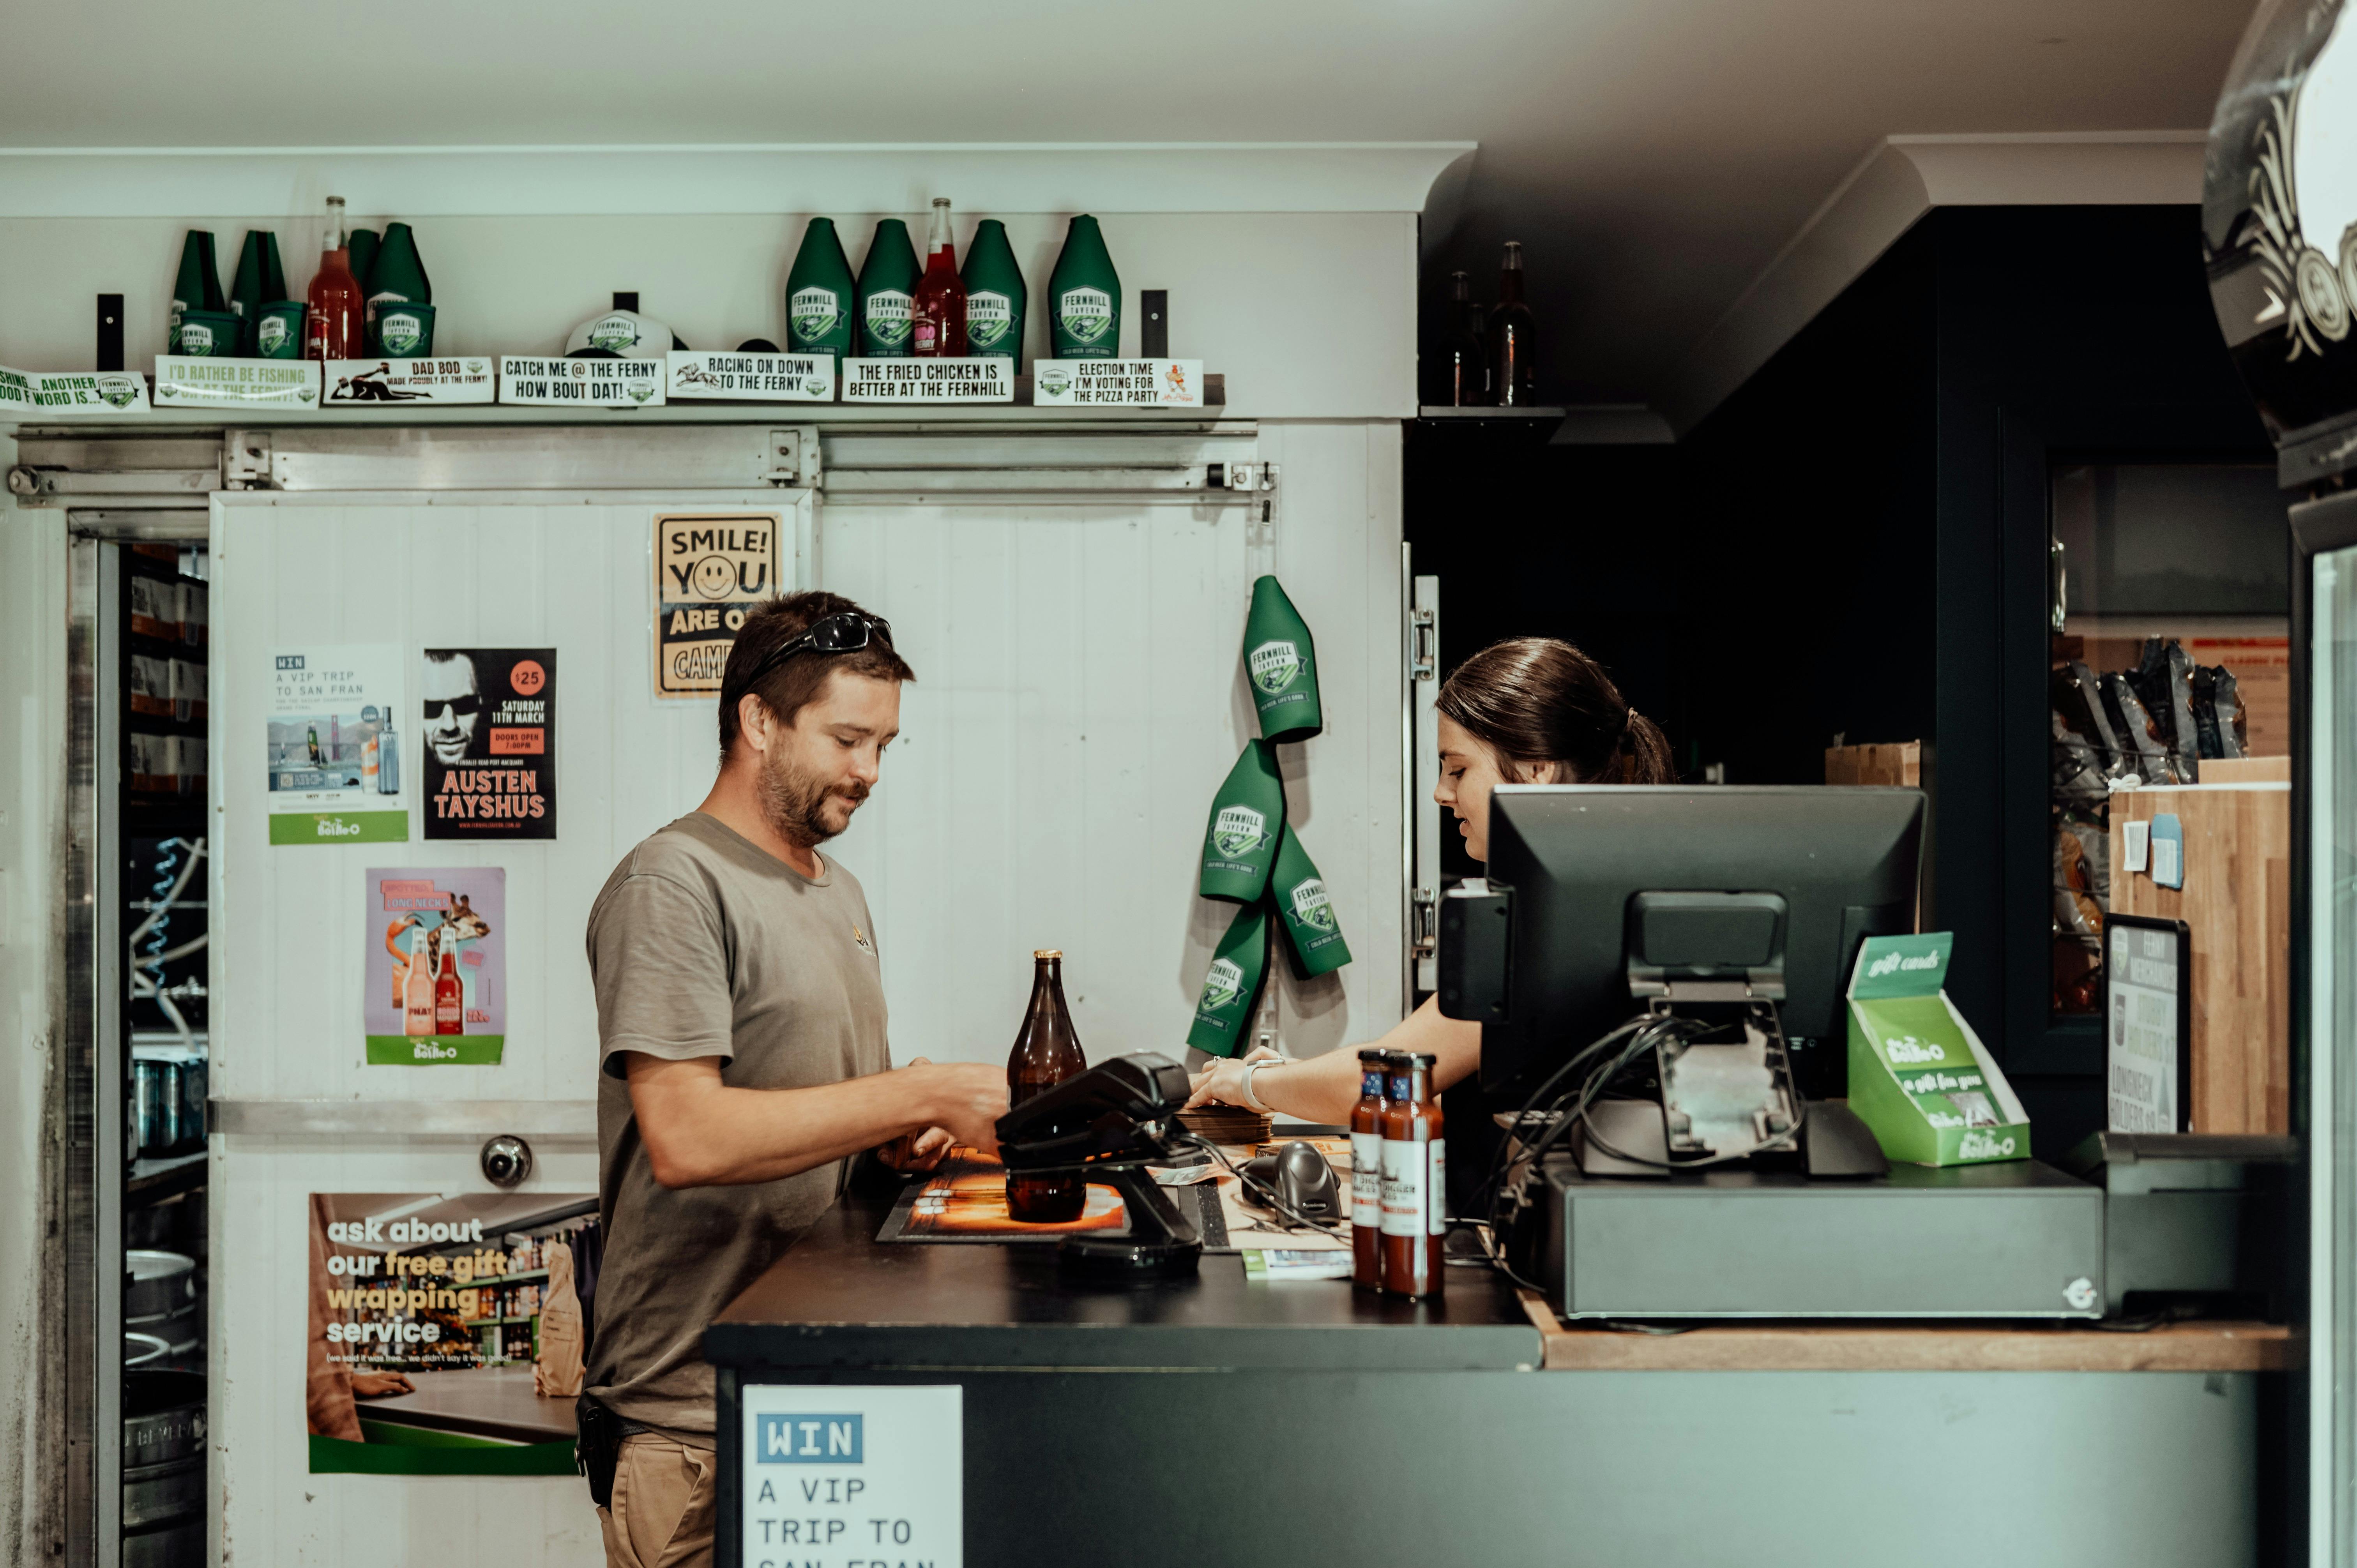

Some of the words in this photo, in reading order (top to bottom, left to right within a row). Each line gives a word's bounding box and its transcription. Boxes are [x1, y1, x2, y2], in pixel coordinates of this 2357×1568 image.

[794, 295, 832, 306] FERNHILL
[871, 298, 912, 309] FERNHILL
[1065, 295, 1107, 306] FERNHILL
[797, 306, 824, 314] TAVERN
[875, 309, 905, 317] TAVERN
[385, 319, 416, 328] FERNHILL
[598, 322, 631, 331] FERNHILL
[412, 362, 434, 375] DAD
[438, 361, 460, 374] BOD
[506, 361, 544, 376] CATCH
[549, 362, 567, 376] ME
[572, 362, 585, 378] @
[590, 363, 613, 377] THE
[618, 363, 656, 377] FERNY
[709, 358, 752, 373] RACING
[758, 359, 773, 373] ON
[778, 360, 813, 374] DOWN
[859, 365, 881, 380] THE
[887, 365, 921, 380] FRIED
[927, 364, 980, 380] CHICKEN
[986, 364, 997, 379] IS
[1080, 364, 1125, 375] ELECTION
[1129, 363, 1153, 375] TIME
[170, 365, 185, 379] I'D
[190, 365, 237, 381] RATHER
[240, 367, 254, 382] BE
[259, 368, 305, 383] FISHING
[387, 377, 406, 386] MADE
[408, 376, 438, 385] PROUDLY
[441, 376, 448, 384] AT
[451, 376, 463, 384] THE
[42, 377, 96, 391] ANOTHER
[720, 374, 733, 388] TO
[739, 375, 760, 389] THE
[765, 376, 802, 390] FERNY
[850, 383, 894, 396] BETTER
[900, 383, 915, 396] AT
[920, 383, 942, 396] THE
[948, 382, 1006, 396] FERNHILL
[1076, 377, 1091, 389] I'M
[1096, 377, 1131, 388] VOTING
[1135, 377, 1153, 388] FOR
[516, 381, 547, 397] HOW
[553, 382, 586, 399] BOUT
[592, 383, 622, 399] DAT!
[1074, 391, 1091, 402] THE
[1096, 391, 1123, 402] PIZZA
[1127, 390, 1158, 402] PARTY
[24, 390, 30, 403] F
[33, 390, 71, 405] WORD
[78, 390, 101, 404] IS...
[671, 529, 767, 555] SMILE!
[670, 609, 719, 636] ARE
[724, 609, 745, 631] O
[1253, 646, 1291, 664] FERNHILL
[278, 657, 302, 669] WIN
[1258, 658, 1286, 670] TAVERN
[276, 674, 283, 683] A
[292, 673, 315, 682] VIP
[322, 672, 354, 682] TRIP
[515, 672, 539, 685] $25
[276, 686, 291, 696] TO
[300, 685, 323, 695] SAN
[331, 684, 363, 694] FRAN
[502, 701, 545, 712] SATURDAY
[493, 713, 512, 724] 11TH
[515, 712, 544, 724] MARCH
[442, 770, 537, 793] AUSTEN
[434, 795, 545, 818] TAYSHUS
[1221, 812, 1259, 826] FERNHILL
[1223, 823, 1250, 833] TAVERN
[387, 898, 413, 908] LONG
[415, 897, 449, 908] NECKS
[1868, 952, 1902, 977] gift
[1900, 949, 1940, 971] cards
[409, 1007, 431, 1016] PHAT
[327, 1217, 383, 1242] ask
[390, 1217, 483, 1242] about
[327, 1255, 380, 1276] our
[385, 1249, 447, 1276] free
[453, 1248, 508, 1284] gift
[327, 1282, 479, 1318] wrapping
[327, 1315, 440, 1342] service
[327, 1353, 341, 1362] (we
[343, 1354, 359, 1362] said
[422, 1354, 445, 1362] didn't
[447, 1355, 461, 1364] say
[768, 1421, 852, 1456] WIN
[758, 1480, 776, 1503] A
[802, 1480, 864, 1503] VIP
[758, 1520, 845, 1543] TRIP
[869, 1520, 911, 1543] TO
